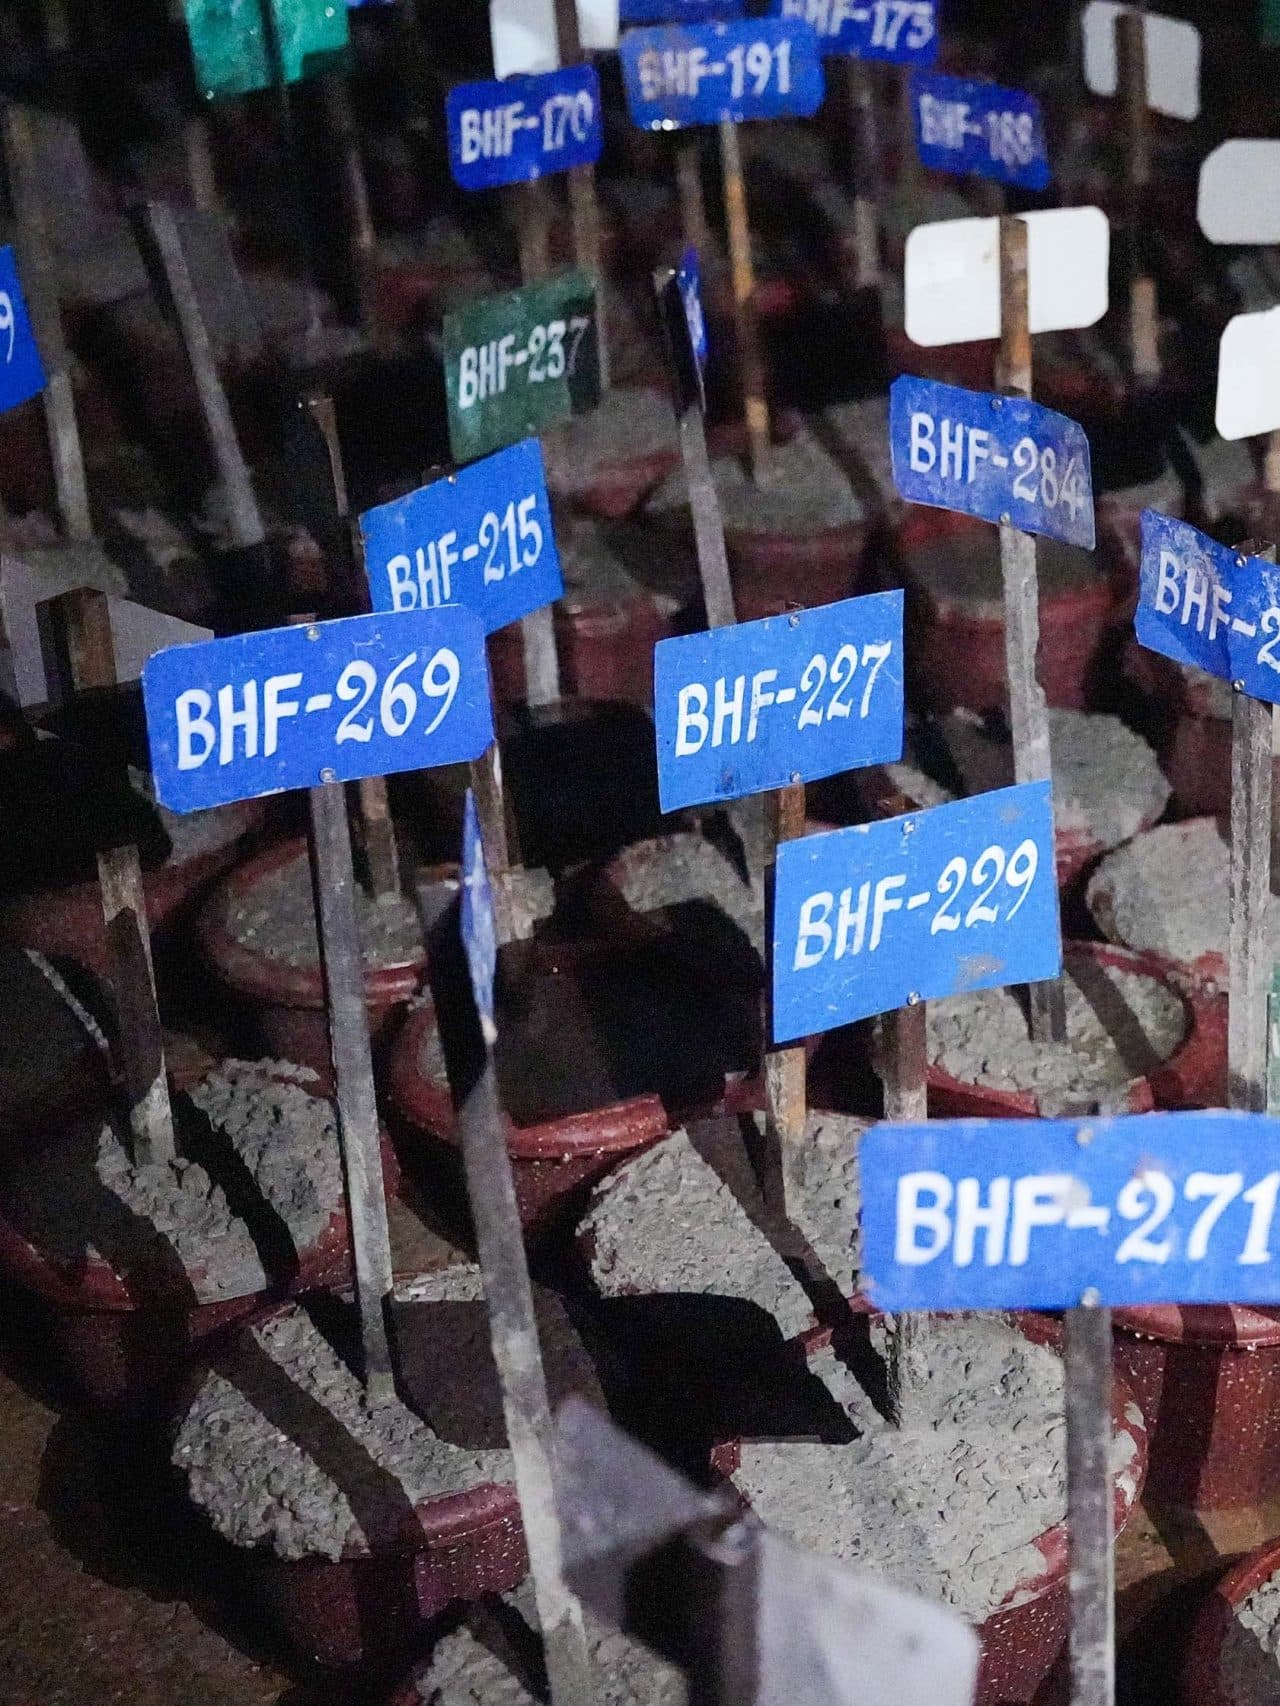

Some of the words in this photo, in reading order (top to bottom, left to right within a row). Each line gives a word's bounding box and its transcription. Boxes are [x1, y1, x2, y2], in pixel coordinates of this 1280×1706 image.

[637, 39, 792, 101] BHF-191
[458, 316, 590, 409] BHF-237
[910, 412, 1084, 521] BHF-284
[386, 494, 544, 611] BHF-215
[175, 647, 462, 771] BHF-269
[674, 640, 894, 758] BHF-227
[791, 838, 1040, 973] BHF-229
